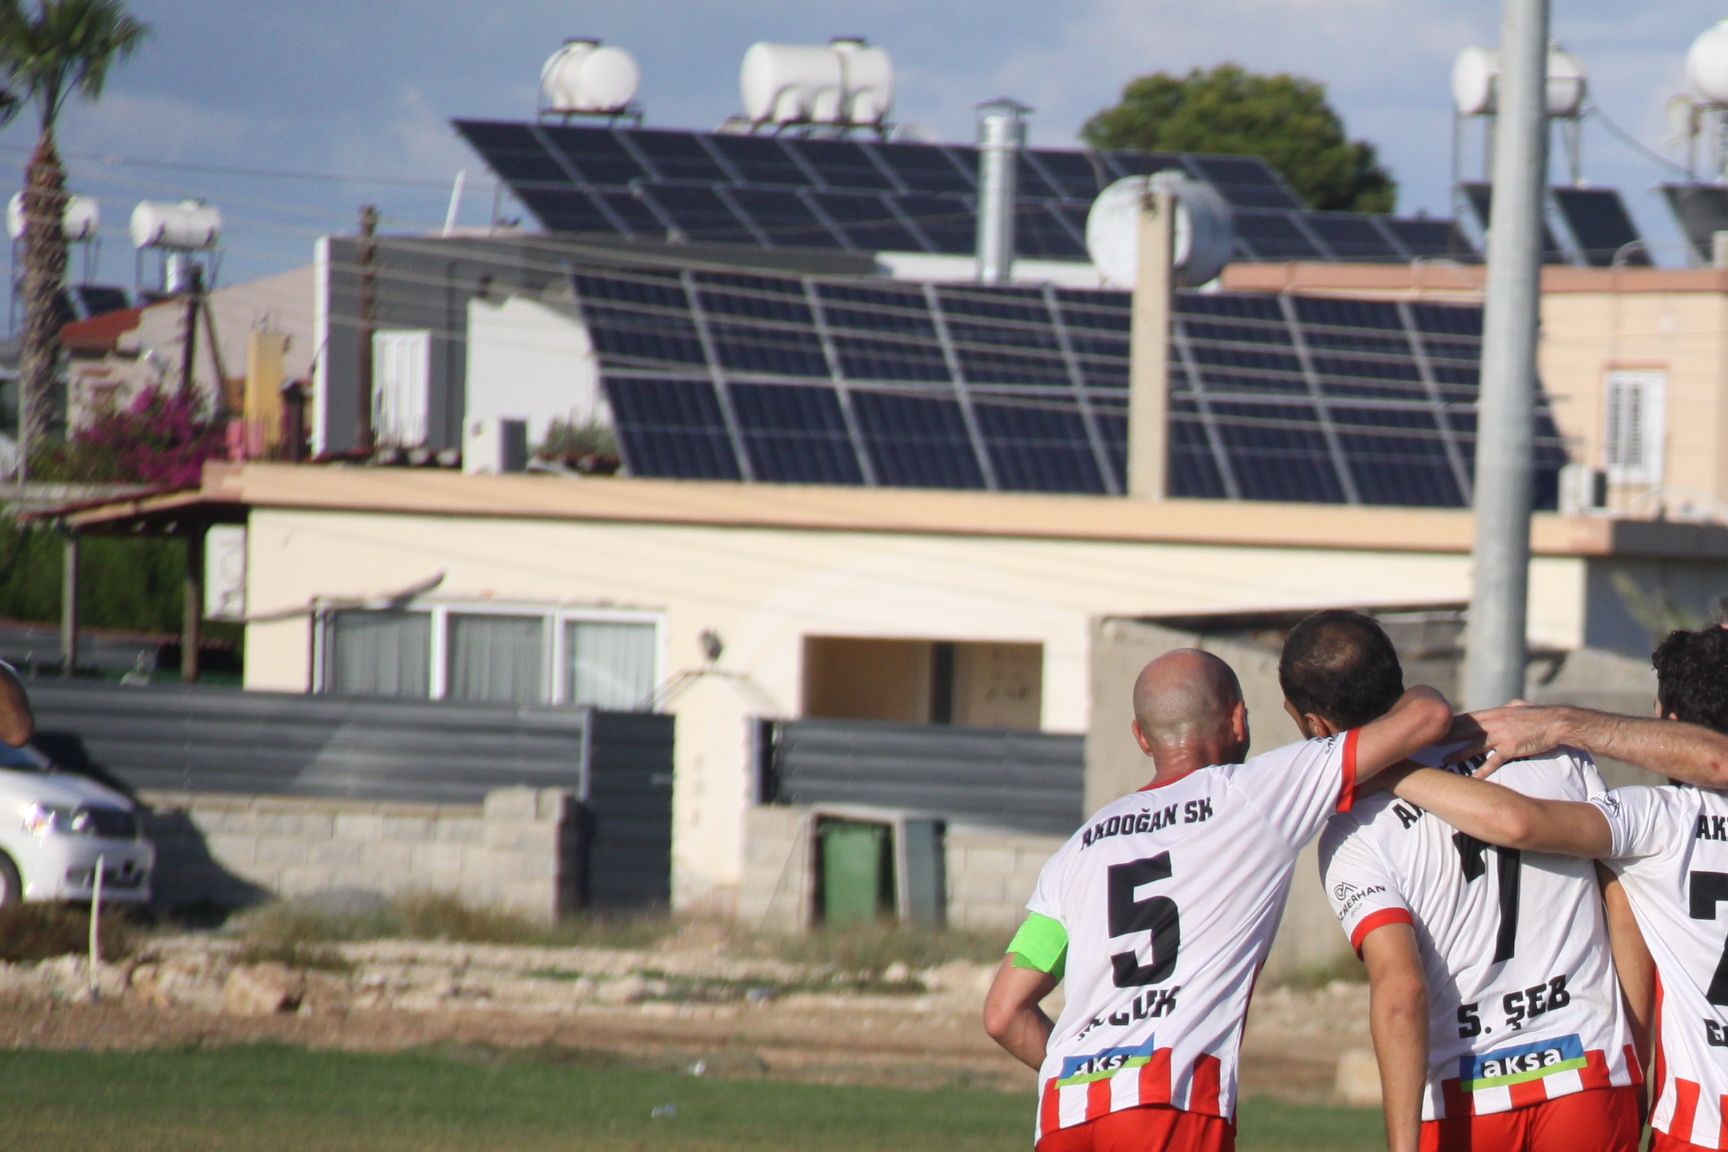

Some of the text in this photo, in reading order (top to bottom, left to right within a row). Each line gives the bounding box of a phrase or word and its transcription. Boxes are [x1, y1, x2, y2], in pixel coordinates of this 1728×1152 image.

[1080, 797, 1213, 851] AKDOĞAN SK
[1107, 851, 1181, 988] 5
[1452, 829, 1522, 964] 7
[1484, 1048, 1562, 1078] aksa
